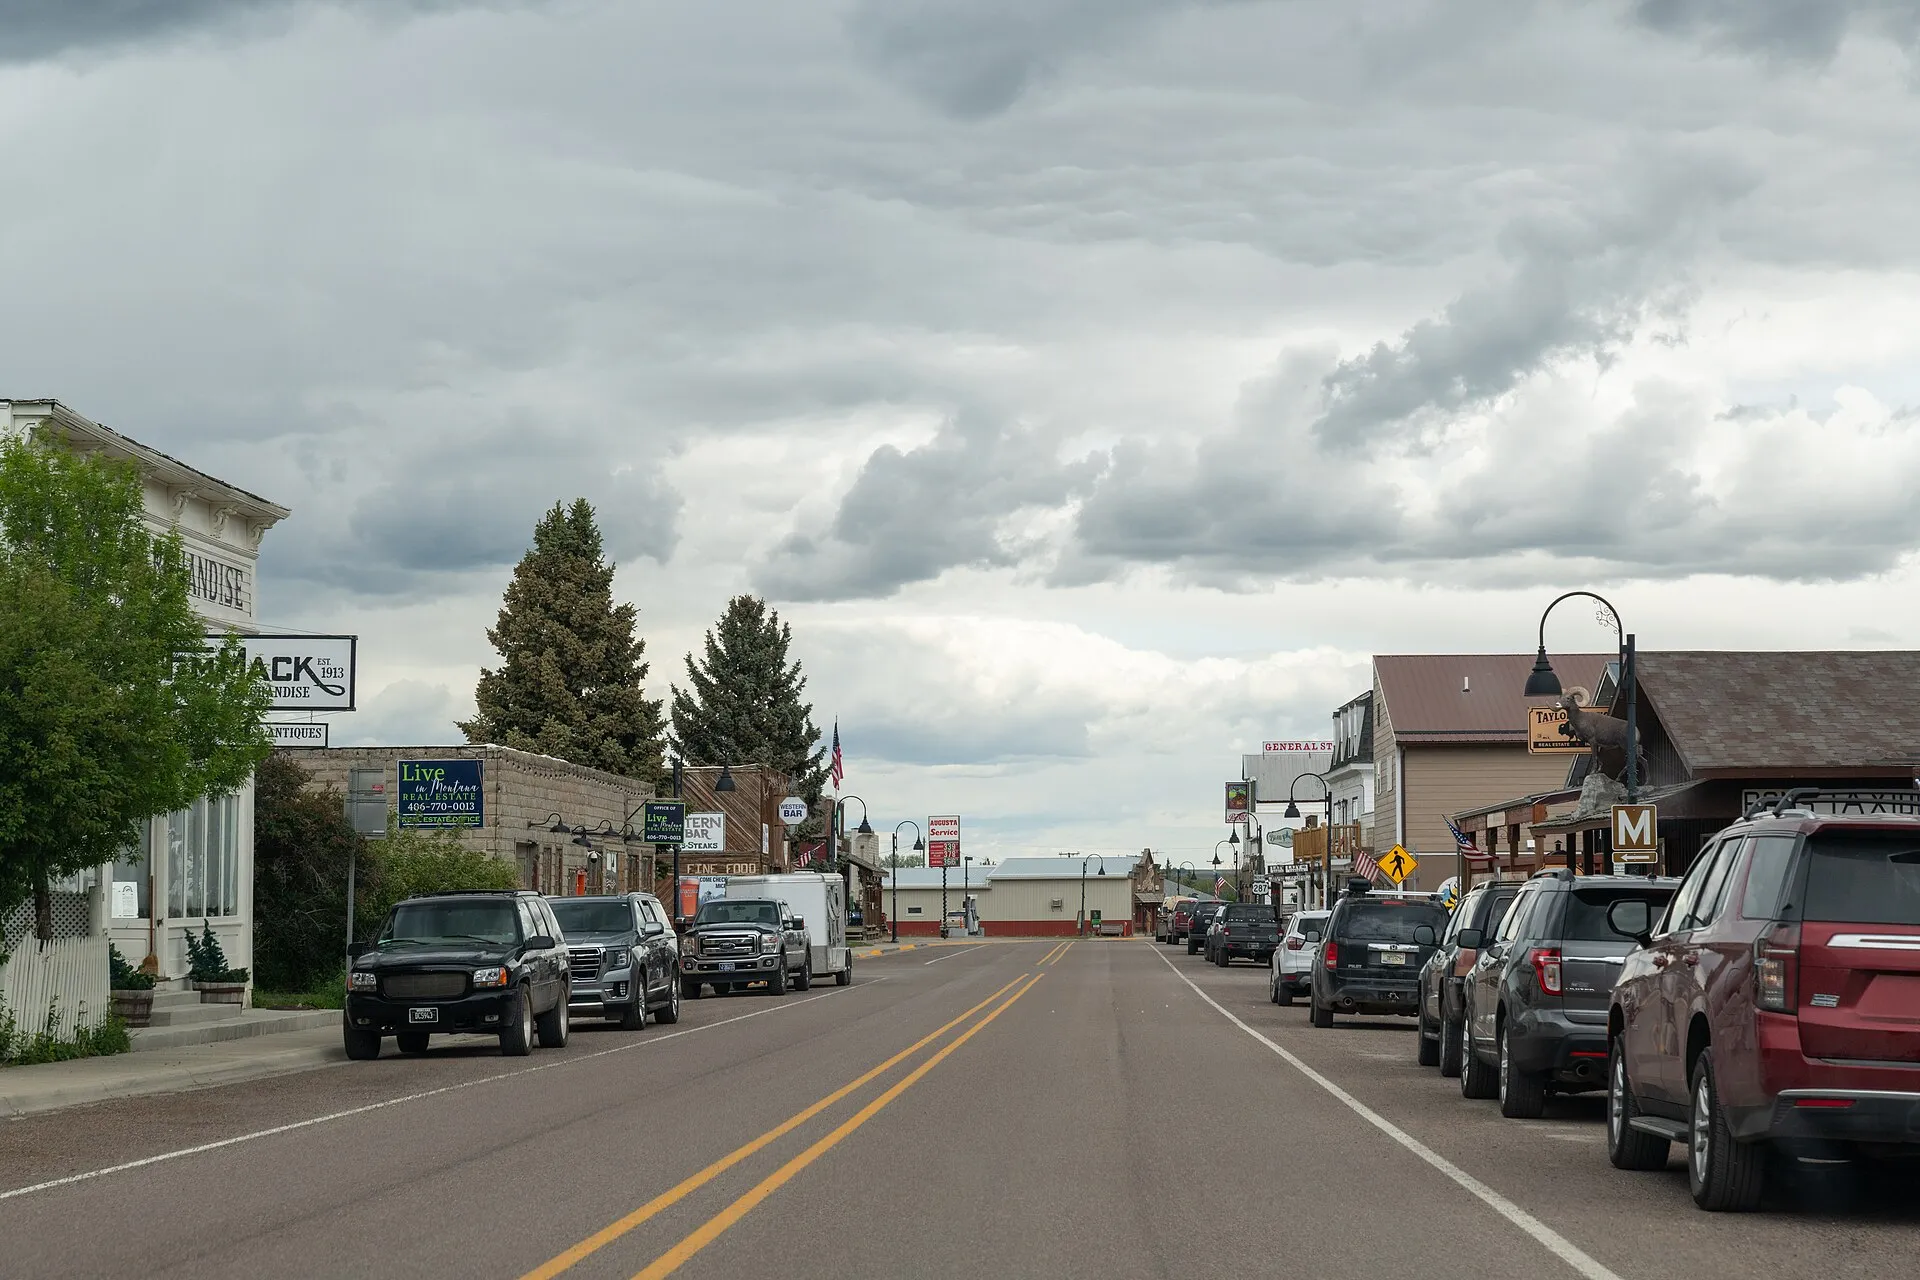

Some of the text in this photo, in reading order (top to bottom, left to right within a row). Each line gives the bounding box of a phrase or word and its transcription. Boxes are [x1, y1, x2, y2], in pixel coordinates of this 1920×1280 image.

[321, 667, 344, 679] 1913
[1536, 711, 1569, 724] TAYLO
[1265, 742, 1318, 751] GENERAL
[402, 763, 445, 782] Live
[415, 778, 480, 797] in Montana
[402, 792, 477, 801] REAL ESTATE
[407, 802, 476, 812] 406-770-0013
[647, 813, 668, 823] Live
[783, 809, 803, 818] BAR
[686, 817, 721, 829] TERN
[1617, 809, 1651, 846] M
[685, 828, 712, 840] BAR
[930, 828, 958, 836] Service
[687, 863, 756, 874] FINE FOOD
[1253, 884, 1268, 893] 287
